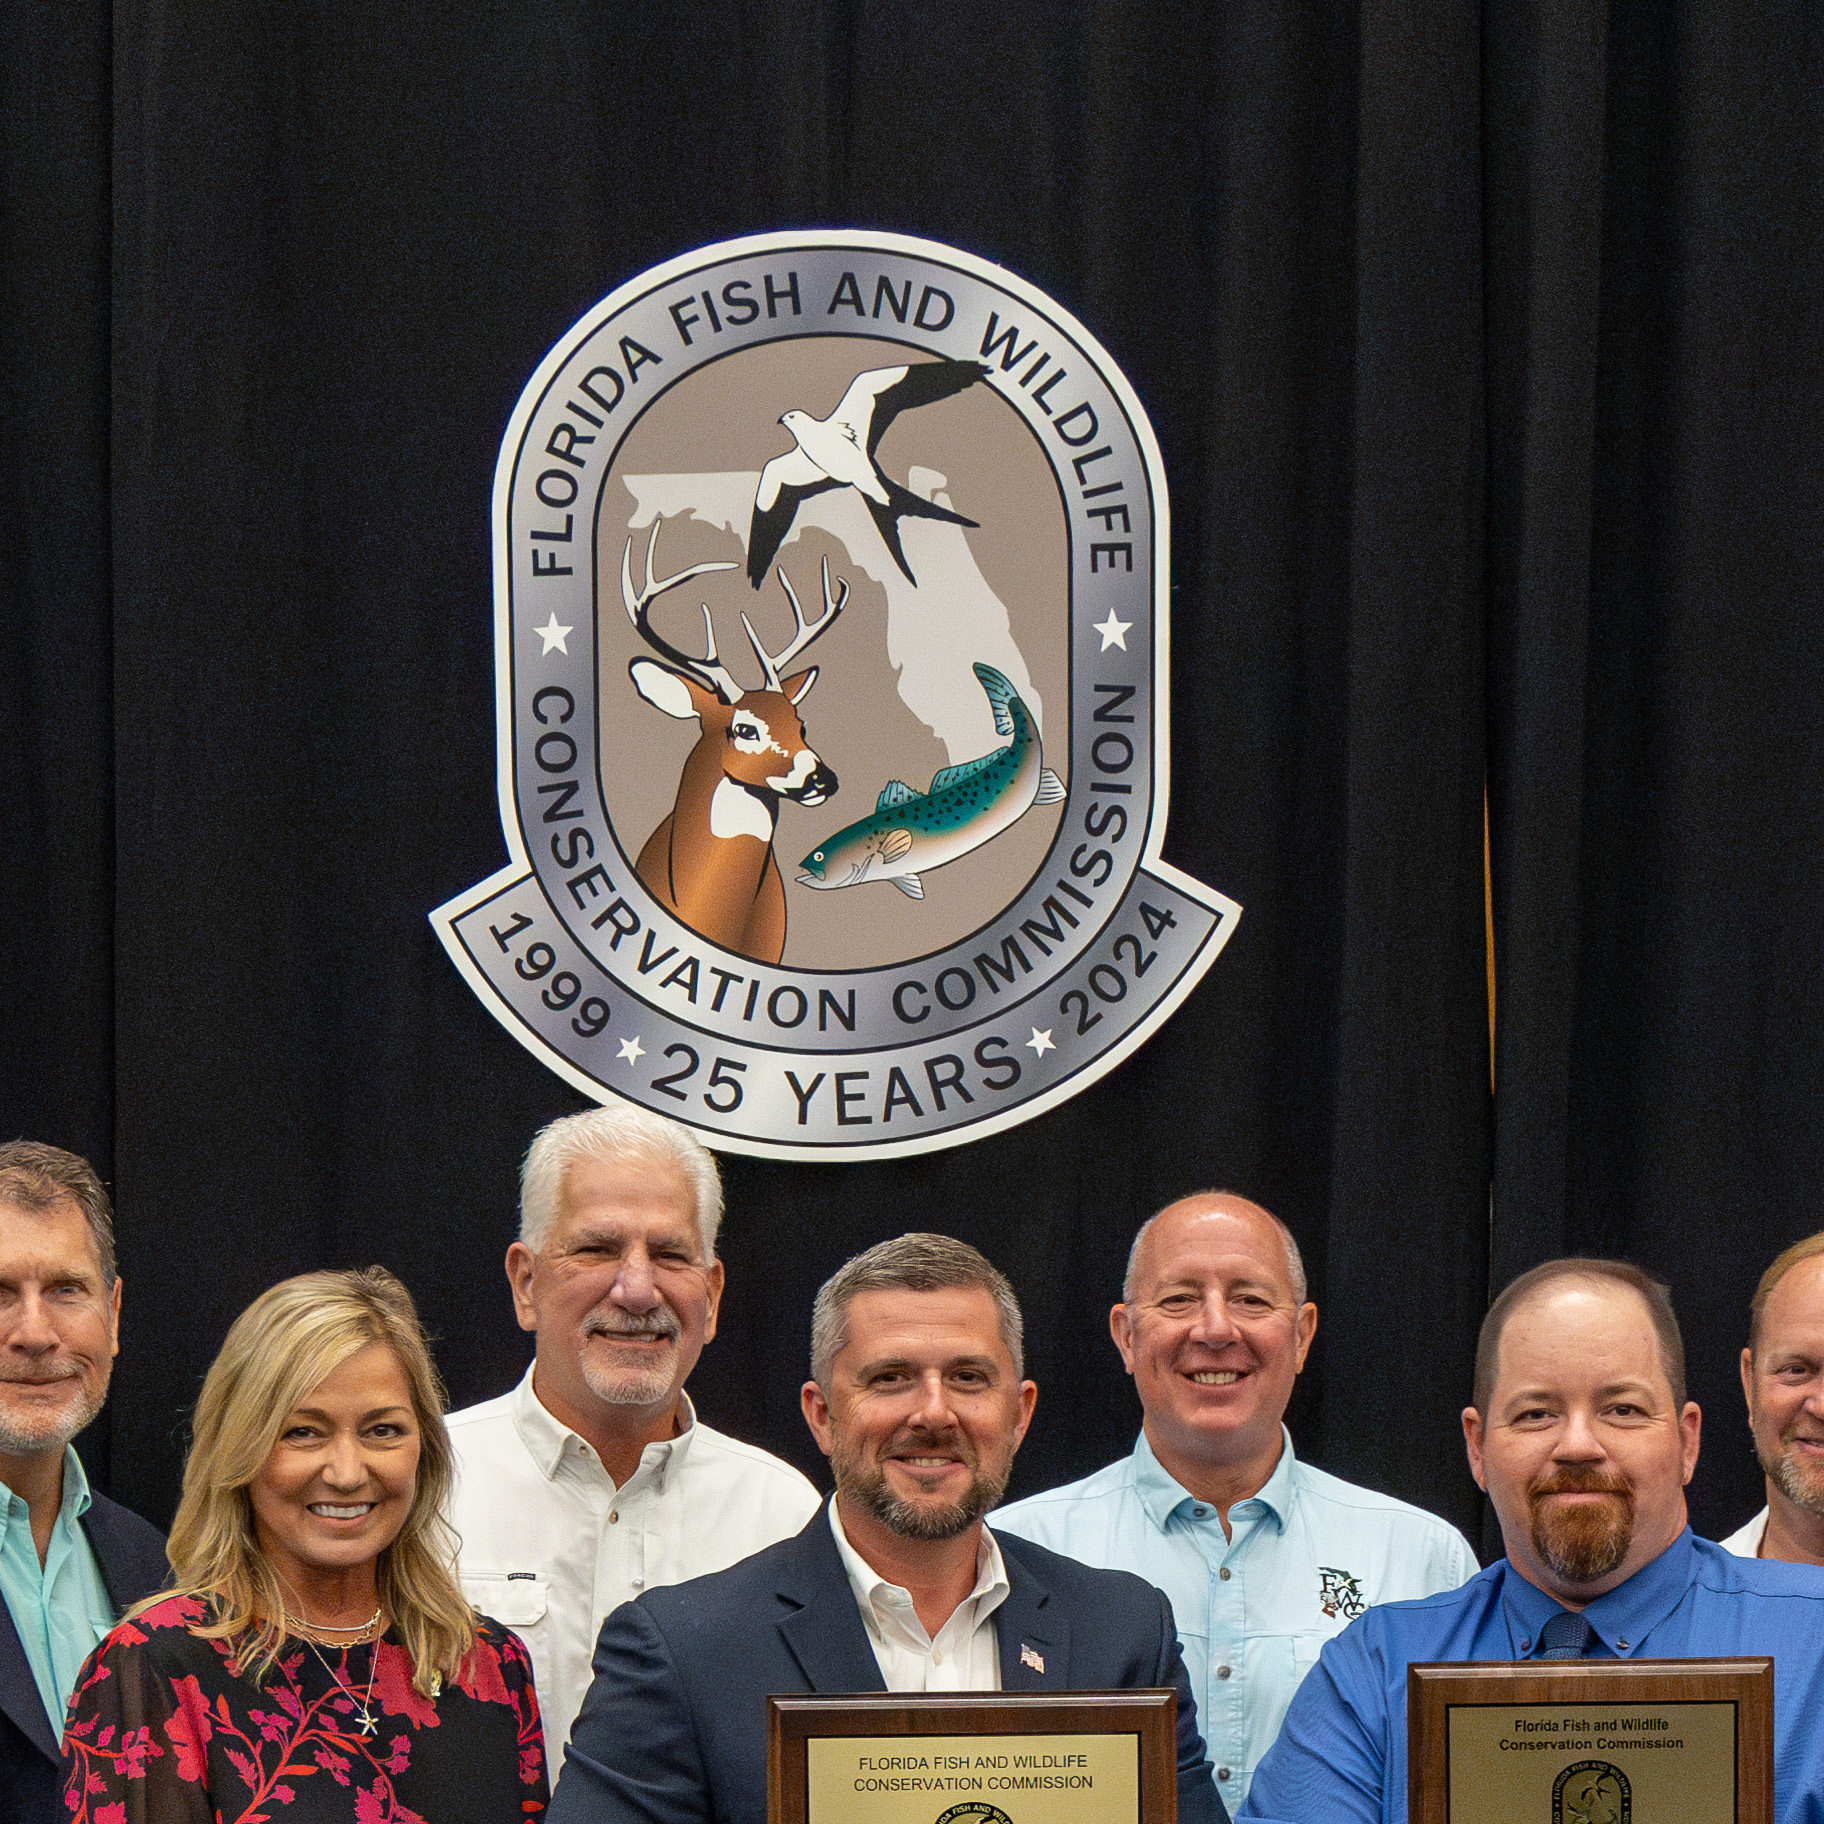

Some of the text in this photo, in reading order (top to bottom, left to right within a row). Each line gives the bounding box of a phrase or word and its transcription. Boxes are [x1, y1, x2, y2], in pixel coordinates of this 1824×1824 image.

[531, 270, 1134, 579] FLORIDA FISH AND WILDLIFE
[534, 682, 1137, 1033] CONSERVATION COMMISSION
[488, 901, 1177, 1125] 1999 25 YEARS 2024
[1514, 1718, 1668, 1732] Florida Fish and Wildlife
[1499, 1737, 1683, 1751] Conservation Commission
[859, 1755, 1088, 1771] FLORIDA FISH AND WILDLIFE
[854, 1776, 1094, 1792] CONSERVATION COMMISSION
[952, 1805, 971, 1814] FISH
[973, 1805, 991, 1813] AND
